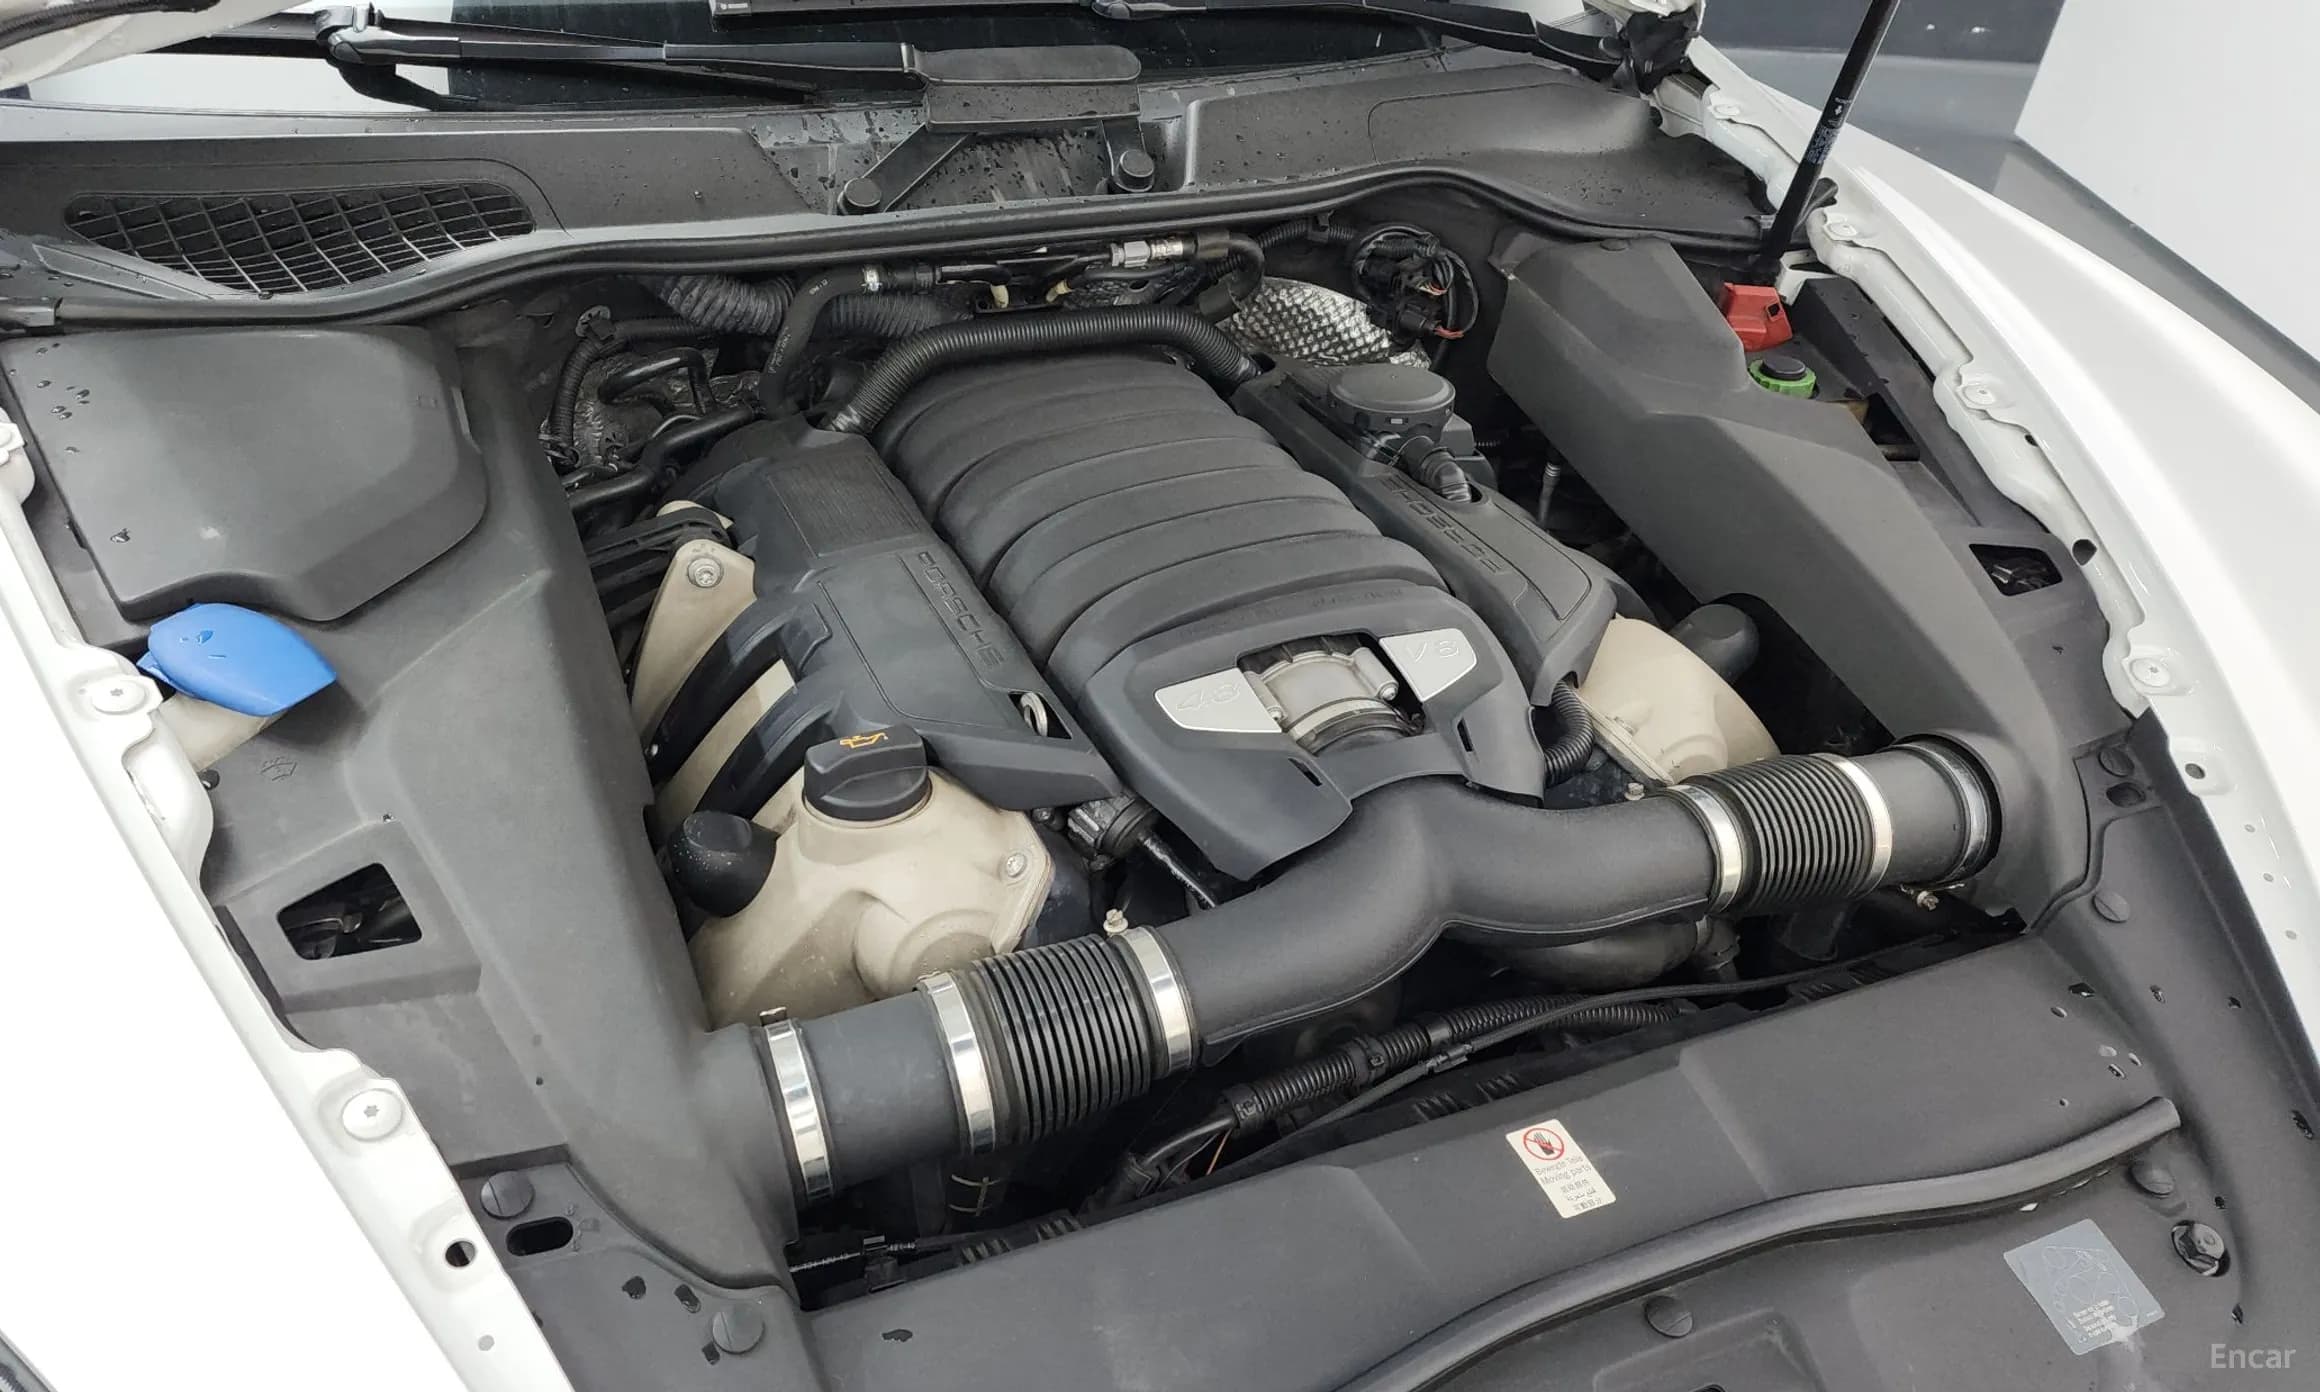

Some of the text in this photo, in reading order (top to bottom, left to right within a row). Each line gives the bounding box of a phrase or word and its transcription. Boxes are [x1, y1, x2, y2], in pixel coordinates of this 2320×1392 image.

[1379, 474, 1502, 574] PORSCHE
[918, 551, 1005, 666] PORSCHE
[1540, 1163, 1592, 1185] Moving parts
